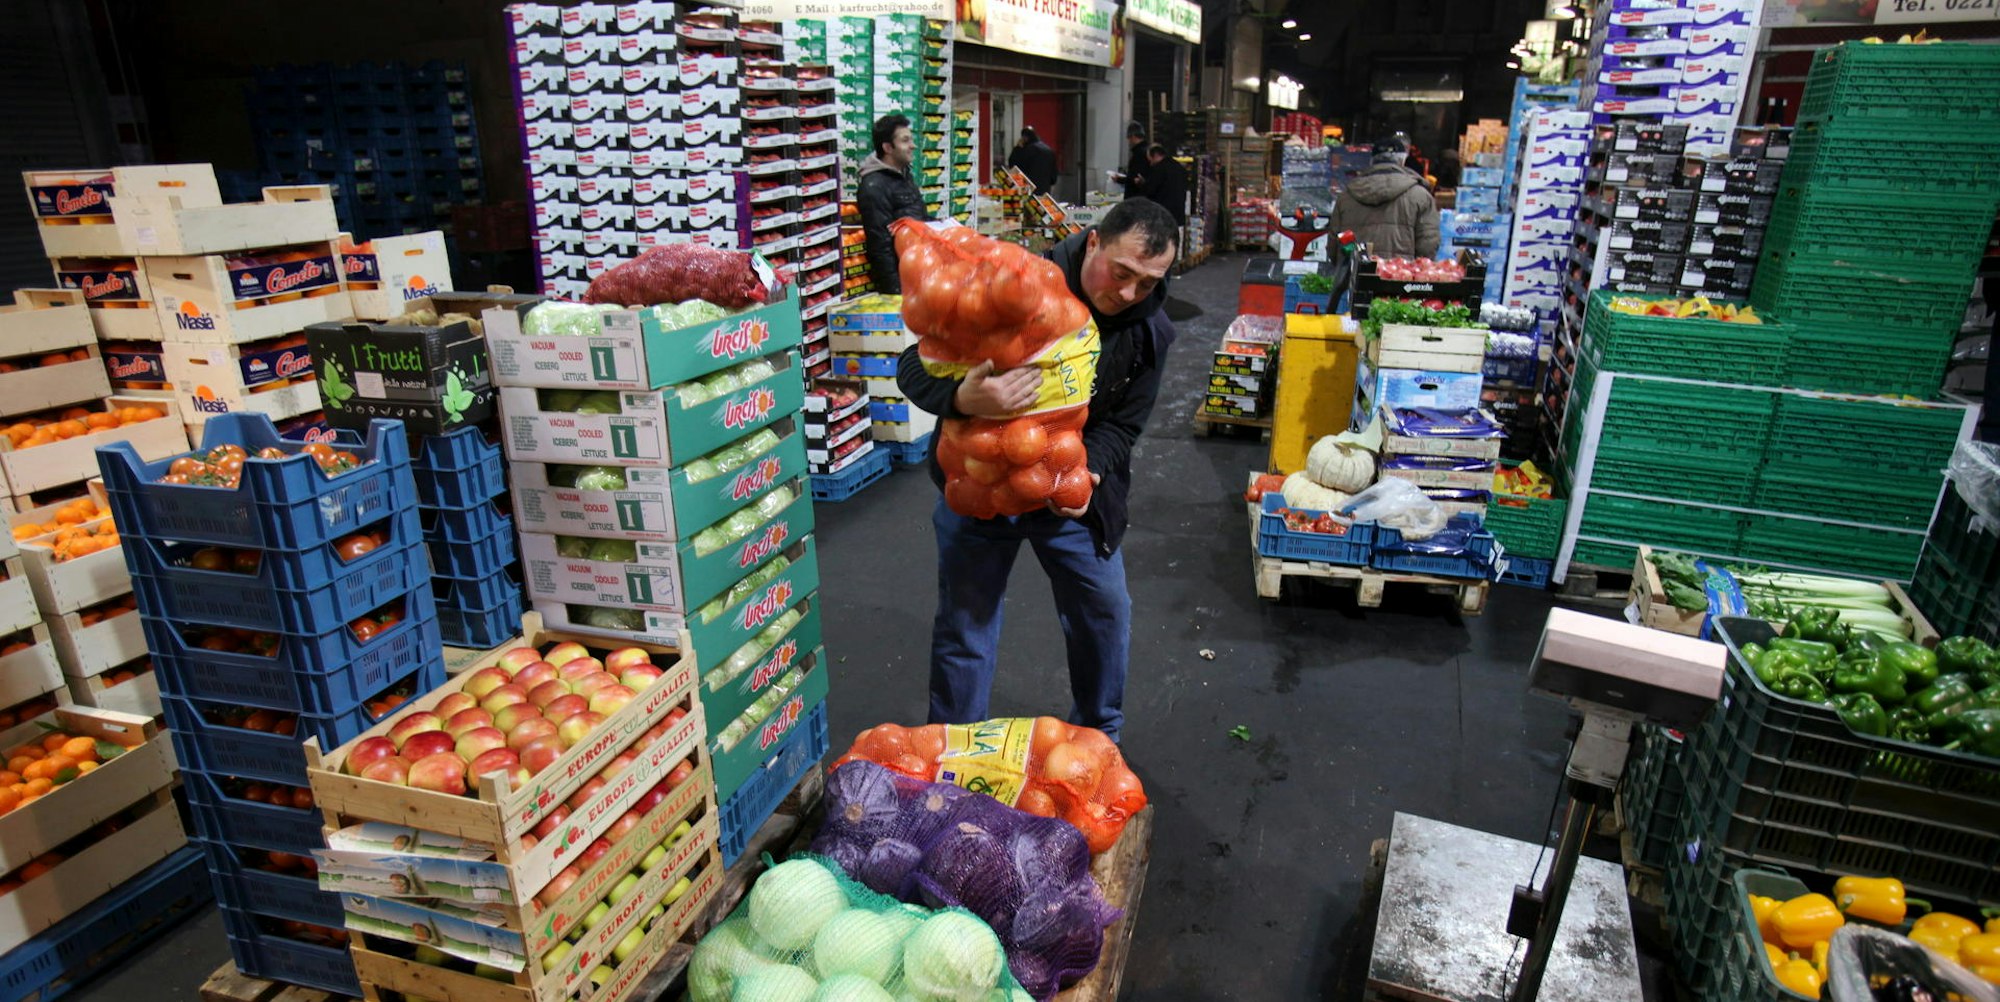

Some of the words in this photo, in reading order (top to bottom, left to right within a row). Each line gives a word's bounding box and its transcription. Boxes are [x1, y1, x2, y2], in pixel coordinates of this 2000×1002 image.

[795, 5, 802, 13] E
[806, 4, 829, 13] Mail
[840, 2, 944, 12] karfrucht@yahoo.de
[1893, 0, 1935, 12] Tel.
[1080, 5, 1109, 31] GmbH
[56, 186, 102, 215] Cometa
[266, 260, 322, 293] Cometa
[82, 273, 124, 299] Cometa
[530, 341, 556, 350] VACUUM
[350, 343, 359, 369] I
[362, 342, 424, 372] Frutti
[558, 351, 584, 361] COOLED
[534, 361, 560, 371] ICEBERG
[562, 372, 588, 382] LETTUCE
[549, 418, 575, 428] VACUUM
[578, 429, 603, 439] COOLED
[552, 437, 578, 447] ICEBERG
[581, 448, 608, 458] LETTUCE
[555, 492, 580, 503] VACUUM
[583, 503, 608, 513] COOLED
[560, 510, 585, 520] ICEBERG
[588, 521, 615, 531] LETTUCE
[566, 563, 592, 574] VACUUM
[594, 575, 619, 585] COOLED
[571, 581, 596, 592] ICEBERG
[598, 593, 624, 604] LETTUCE
[567, 730, 618, 778] EUROPE
[646, 668, 691, 713] QUALITY
[588, 773, 635, 823] EUROPE
[651, 719, 696, 767] QUALITY
[578, 846, 631, 902] EUROPE
[651, 782, 700, 834] QUALITY
[661, 830, 705, 880] QUALITY
